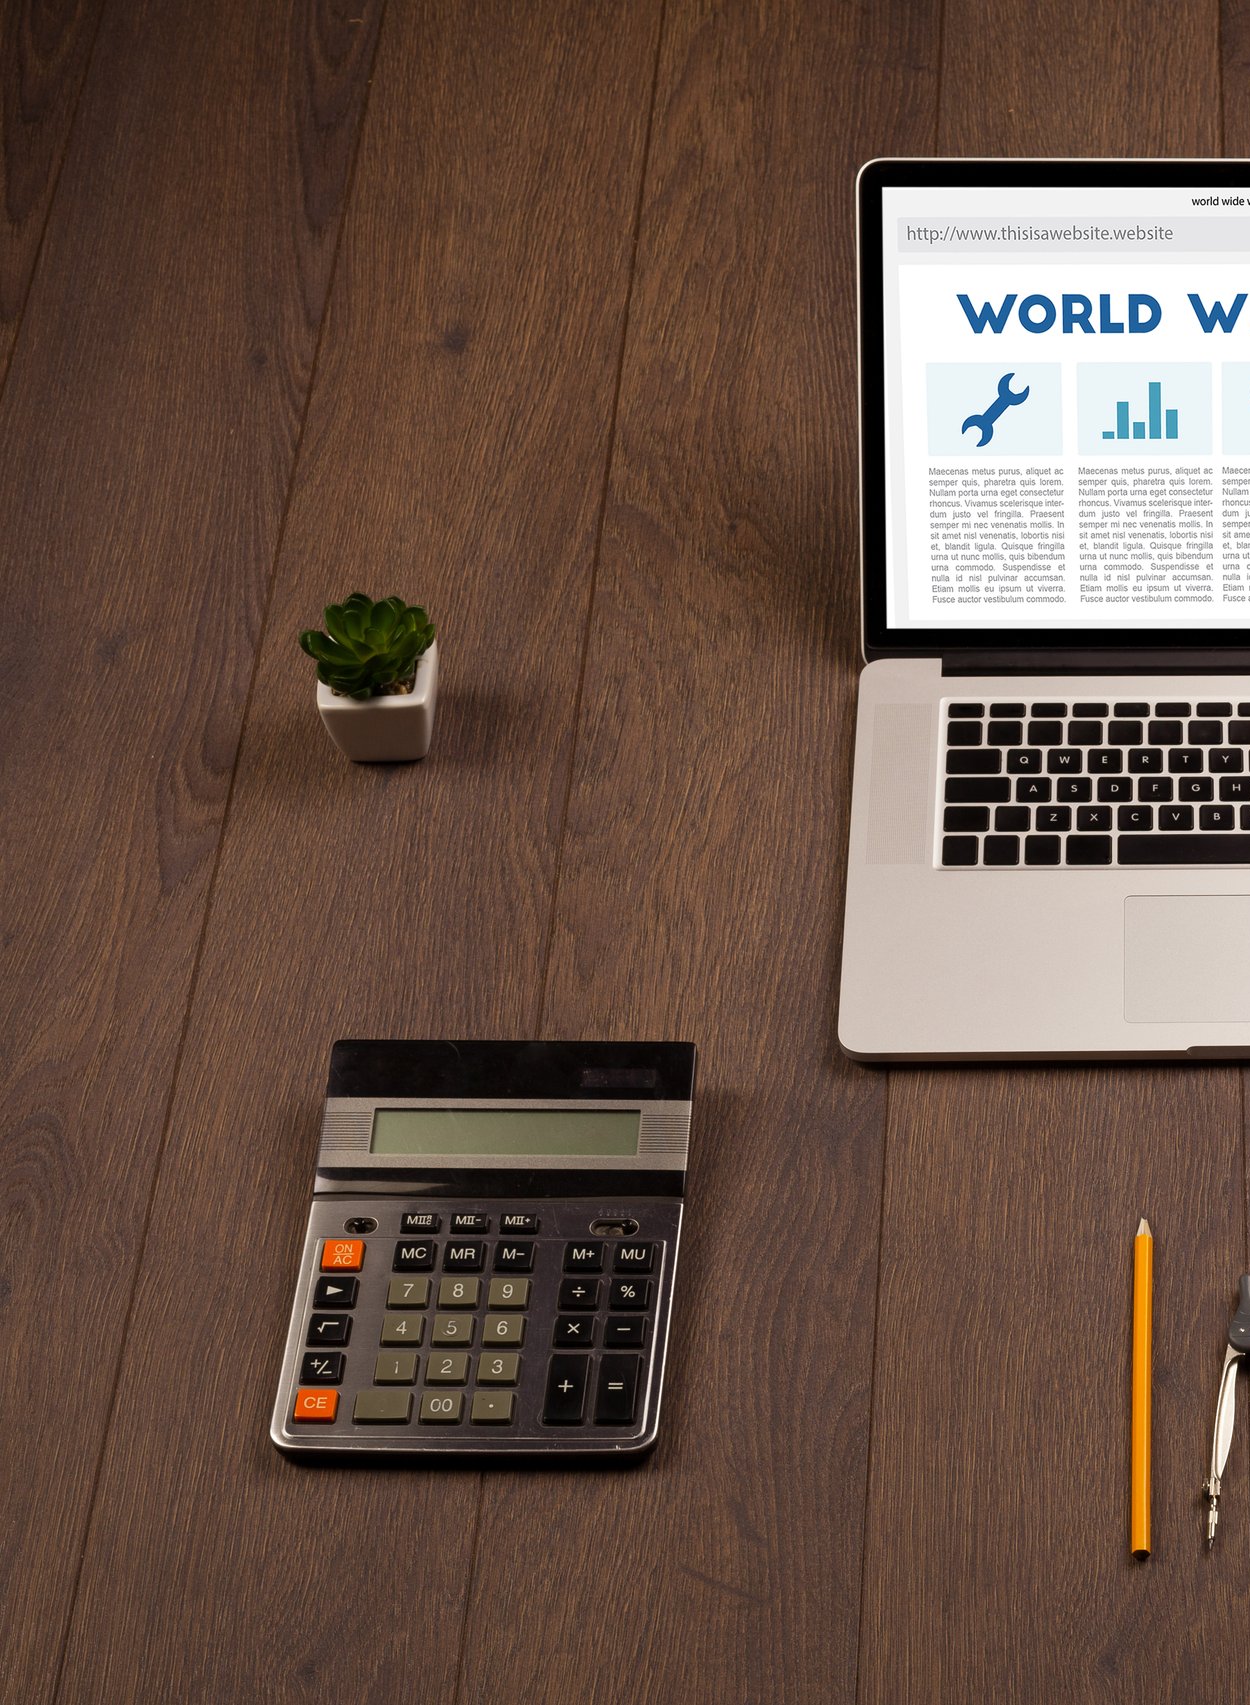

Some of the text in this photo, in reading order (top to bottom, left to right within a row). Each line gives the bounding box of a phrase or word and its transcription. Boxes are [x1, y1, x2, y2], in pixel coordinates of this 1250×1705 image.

[1191, 196, 1219, 206] world
[1221, 196, 1244, 206] wide
[907, 225, 1173, 244] http://www.thisisawebsite.website
[957, 294, 1161, 333] WORLD
[929, 468, 969, 476] Maecenas
[972, 468, 995, 476] metus
[999, 469, 1022, 478] purus,
[1026, 468, 1051, 478] aliquet
[1078, 467, 1118, 475] Maecenas
[1121, 467, 1145, 475] metus
[1148, 468, 1172, 477] purus,
[1175, 467, 1200, 477] aliquet
[929, 489, 956, 497] Nullam
[958, 489, 978, 499] porta
[1001, 489, 1017, 499] eget
[1020, 489, 1064, 497] consectetur
[1079, 488, 1105, 496] Nullam
[1108, 488, 1128, 498] porta
[1150, 488, 1166, 498] eget
[1169, 488, 1213, 496] consectetur
[1222, 488, 1249, 496] Nullam
[930, 500, 1064, 510] rhoncus. Vivamus scelerisque inter-
[1079, 499, 1213, 509] rhoncus. Vivamus scelerisque inter-
[955, 563, 995, 572] commodo.
[1003, 563, 1051, 574] Suspendisse
[1058, 563, 1065, 572] et
[1104, 563, 1143, 571] commodo.
[1151, 563, 1199, 573] Suspendisse
[1206, 563, 1213, 571] et
[933, 595, 1066, 604] Fusce auctor vestibulum commodo.
[1081, 595, 1214, 603] Fusce auctor vestibulum commodo.
[1223, 594, 1246, 602] Fusce
[334, 1243, 353, 1253] ON
[401, 1247, 427, 1259] MC
[450, 1248, 476, 1260] MR
[572, 1248, 595, 1260] M+
[620, 1248, 646, 1260] MU
[332, 1254, 353, 1265] AC
[403, 1283, 415, 1298] 7
[452, 1283, 464, 1298] 8
[502, 1284, 514, 1299] 9
[620, 1285, 636, 1298] %
[395, 1320, 407, 1335] 4
[446, 1320, 457, 1335] 5
[496, 1320, 508, 1336] 6
[440, 1358, 453, 1374] 2
[491, 1359, 503, 1374] 3
[303, 1396, 328, 1409] CE
[429, 1398, 453, 1413] 00
